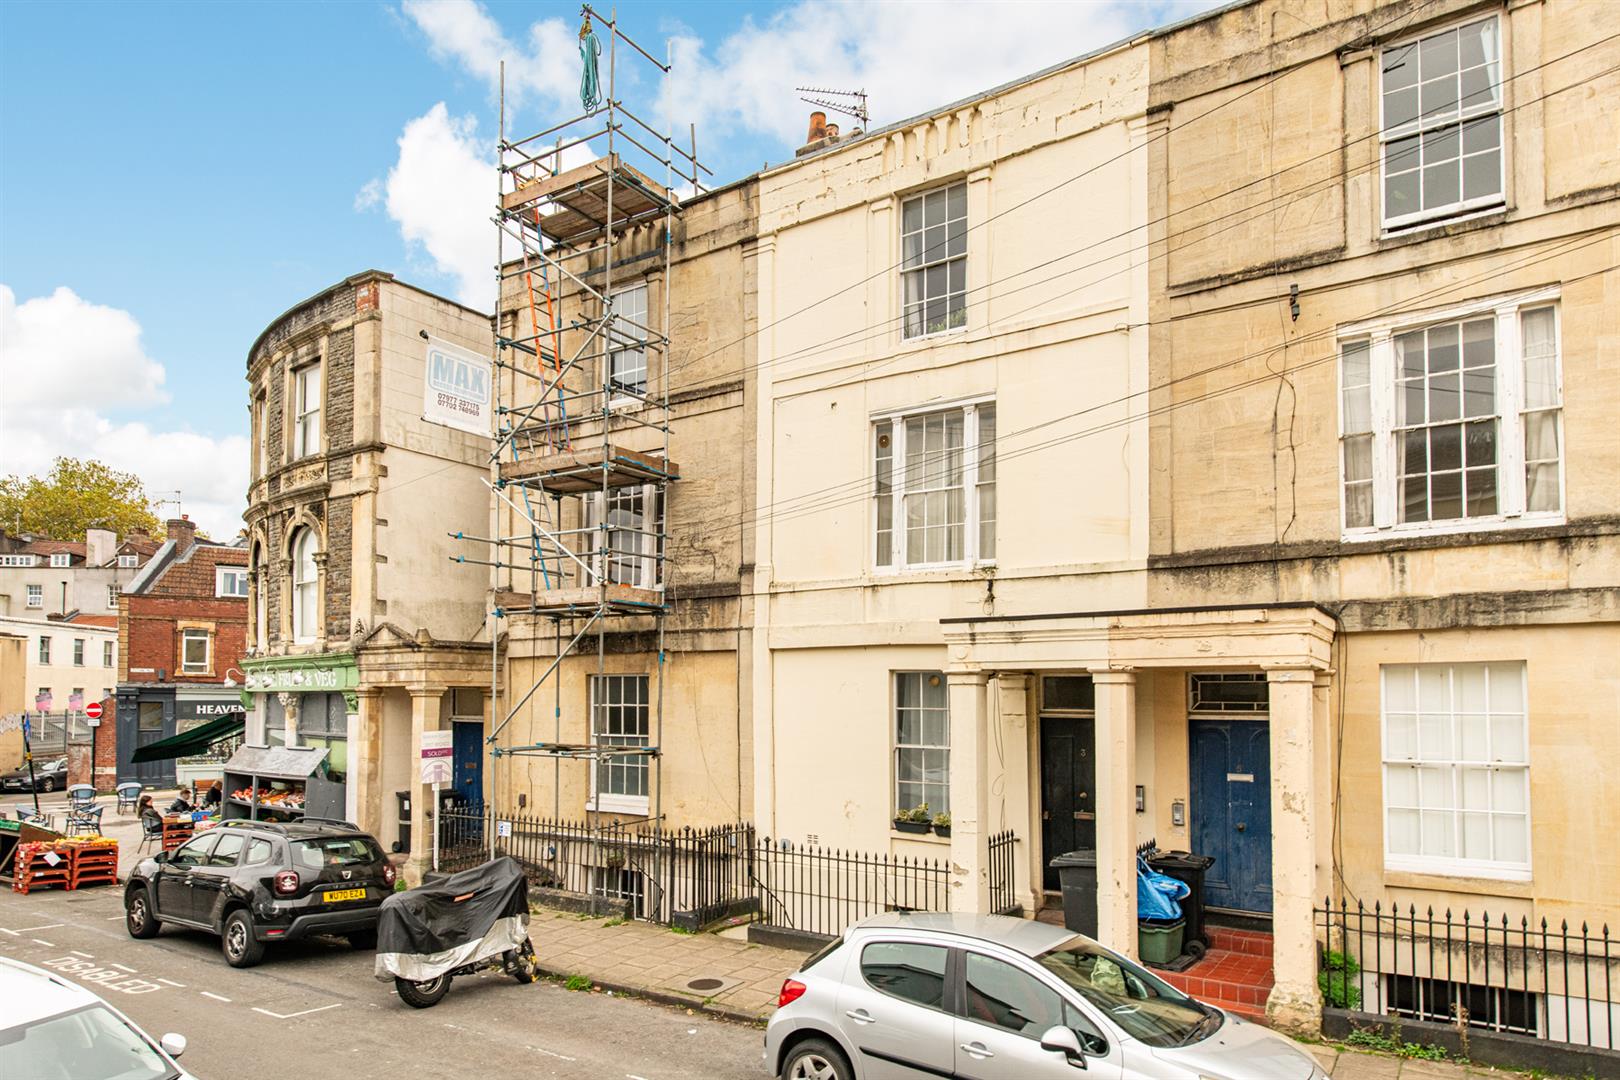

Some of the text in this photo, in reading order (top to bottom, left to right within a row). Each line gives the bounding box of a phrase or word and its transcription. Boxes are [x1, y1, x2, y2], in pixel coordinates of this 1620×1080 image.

[434, 354, 484, 394] MAX
[278, 672, 303, 688] FRU
[315, 671, 336, 688] VEG
[42, 957, 160, 993] DISABLED
